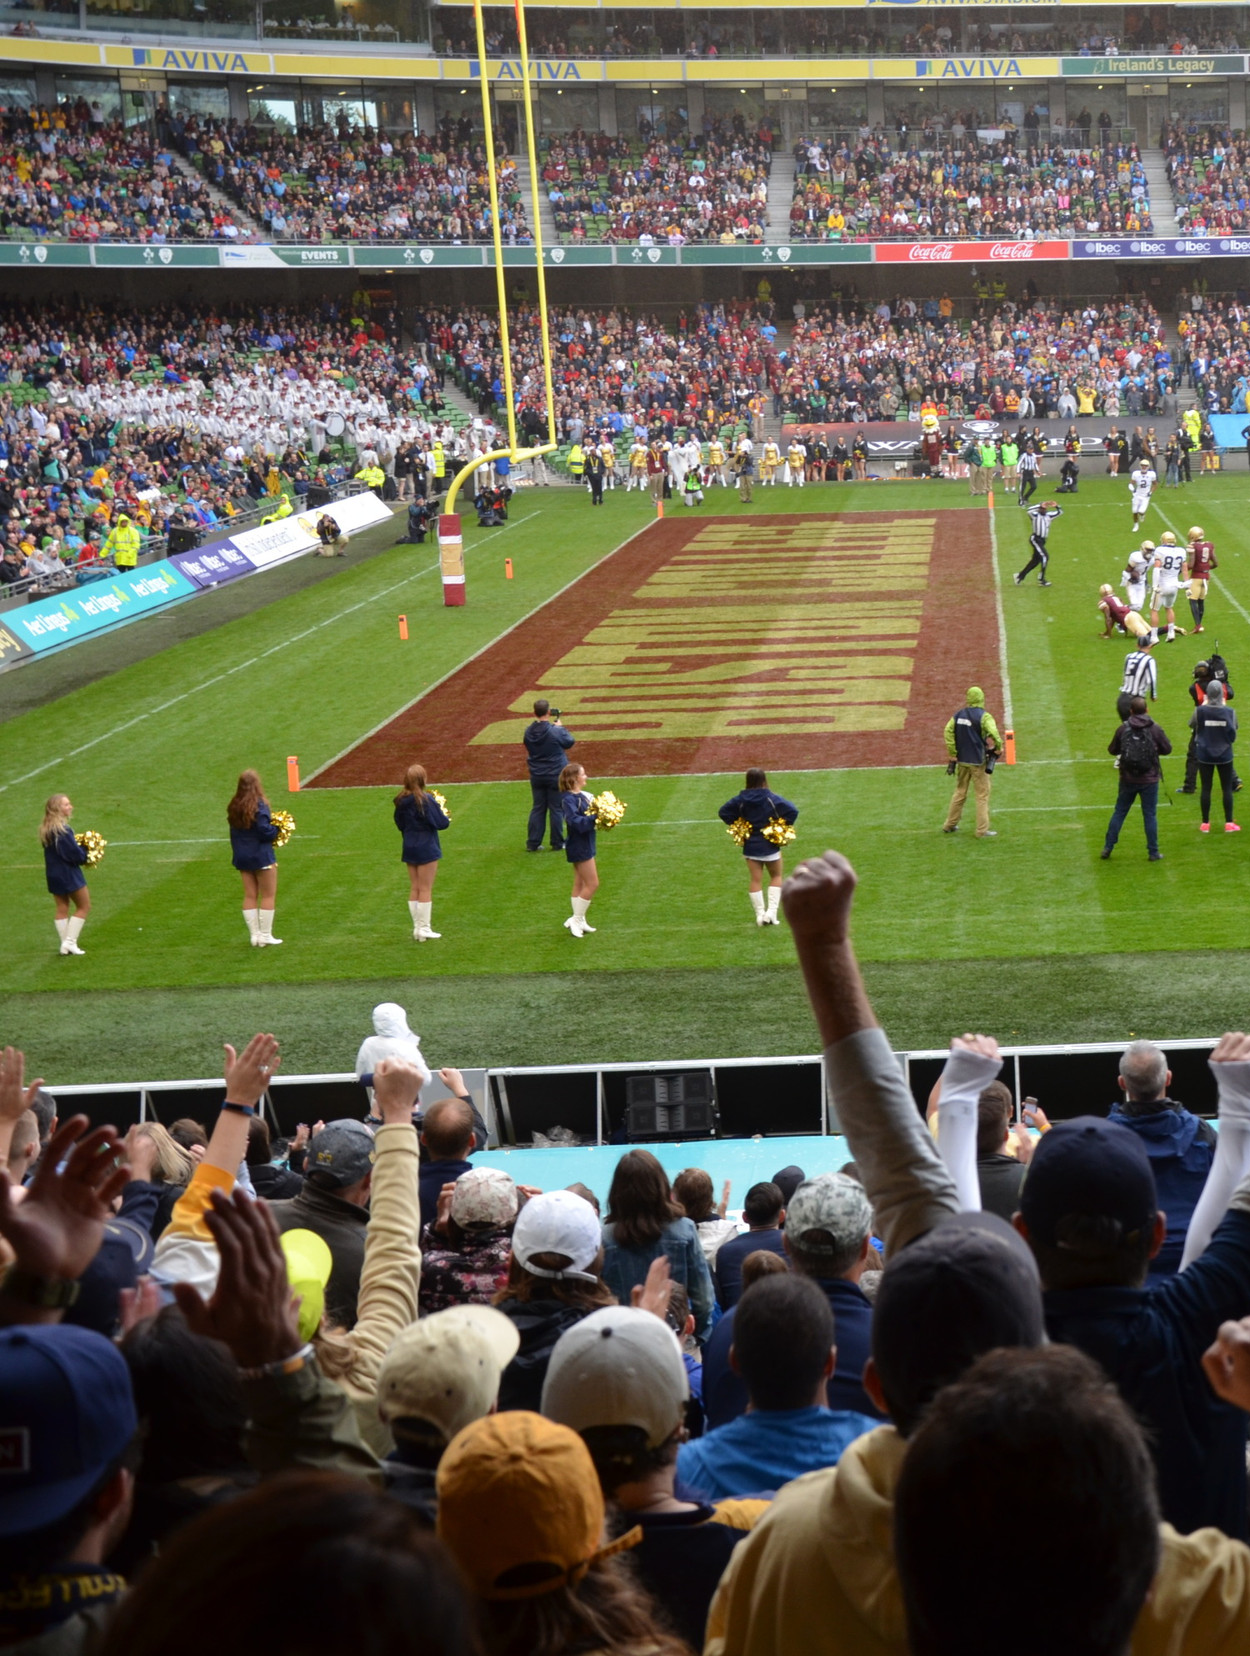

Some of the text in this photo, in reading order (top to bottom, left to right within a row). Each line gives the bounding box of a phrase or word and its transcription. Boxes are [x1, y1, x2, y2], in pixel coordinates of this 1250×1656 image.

[162, 50, 249, 72] AVIVA
[941, 59, 1022, 77] AVIVA
[1108, 58, 1215, 73] Ireland's Legacy
[497, 62, 582, 80] AVIVA
[301, 251, 338, 260] EVENTS
[1140, 480, 1147, 489] 2
[1163, 556, 1184, 570] 83
[140, 576, 171, 595] Lingus
[88, 592, 123, 613] Lingus
[37, 611, 71, 632] Lingus
[1126, 659, 1138, 675] F
